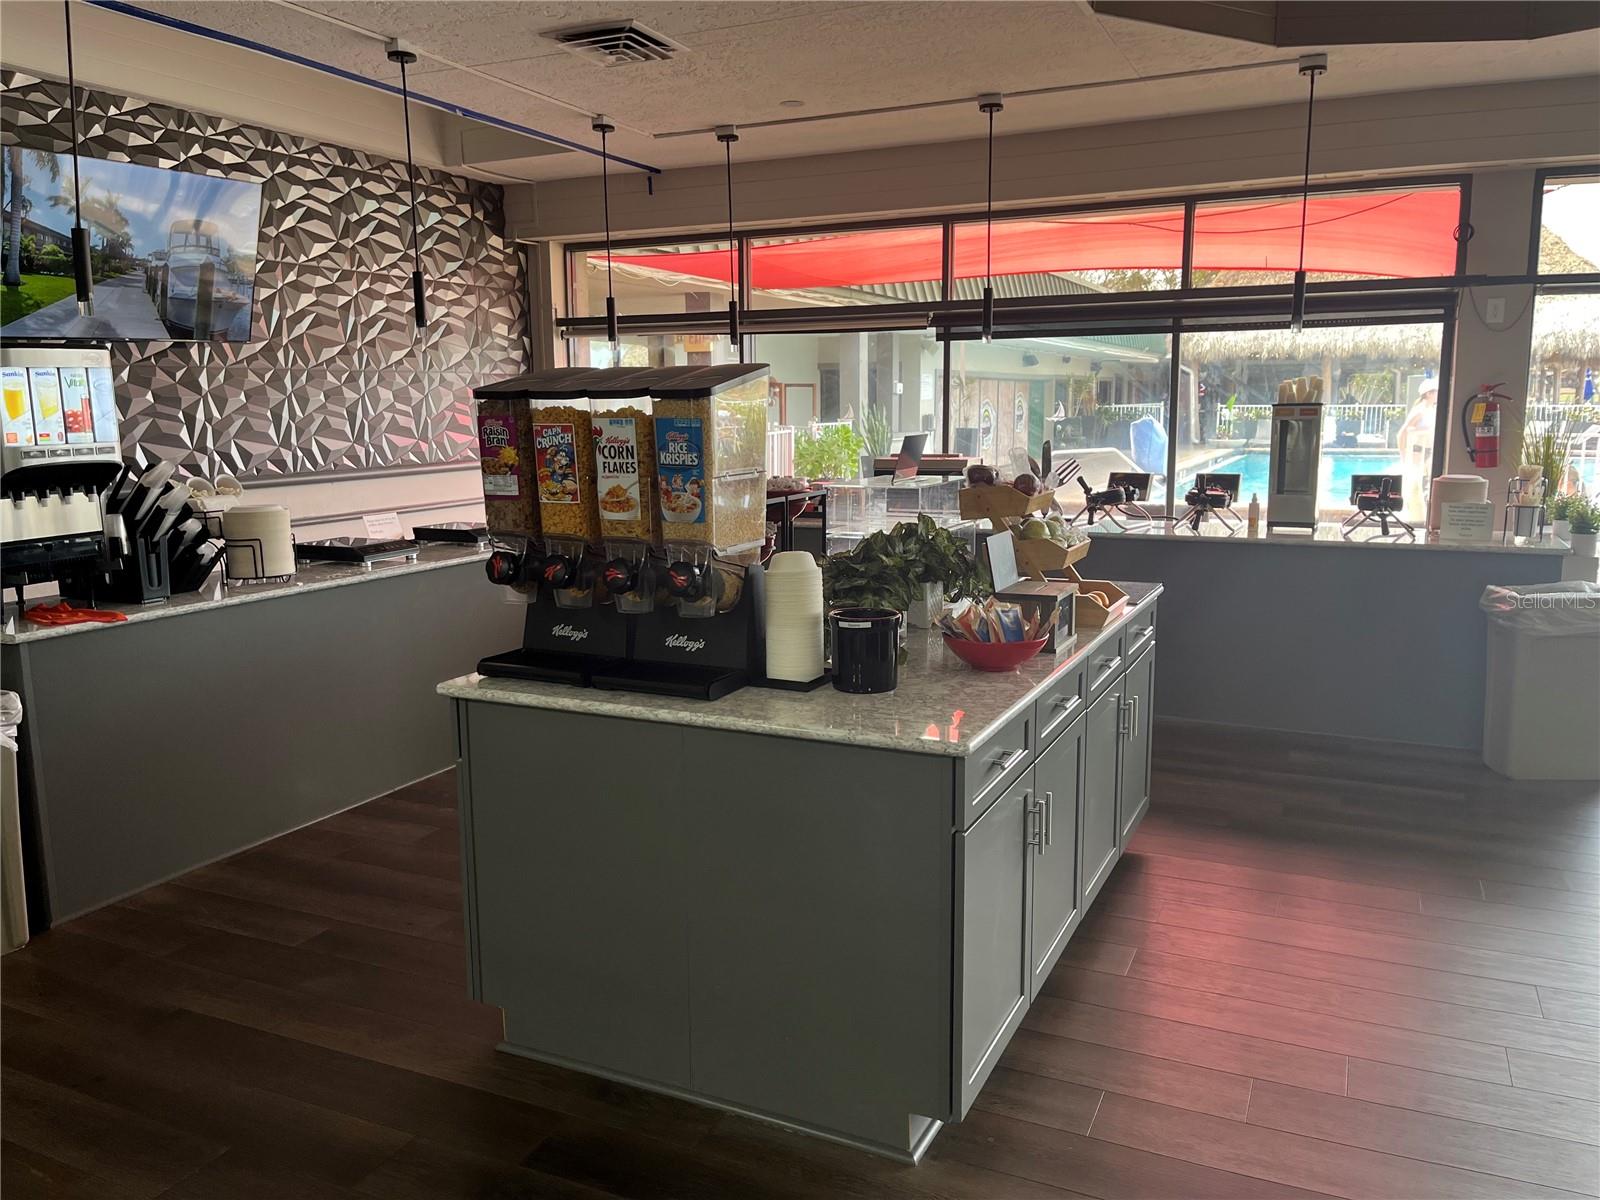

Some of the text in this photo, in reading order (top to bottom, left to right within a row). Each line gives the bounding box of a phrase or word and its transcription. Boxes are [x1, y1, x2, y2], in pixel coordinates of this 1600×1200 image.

[482, 426, 509, 439] Raisin
[485, 436, 508, 448] Bran
[536, 433, 572, 449] CRUNCH
[668, 442, 688, 453] RICE
[602, 445, 635, 460] CORN
[660, 450, 700, 466] KRISPIES
[602, 461, 637, 474] FLAKES
[552, 624, 589, 641] Kellogg's
[665, 634, 705, 652] Kellogg's
